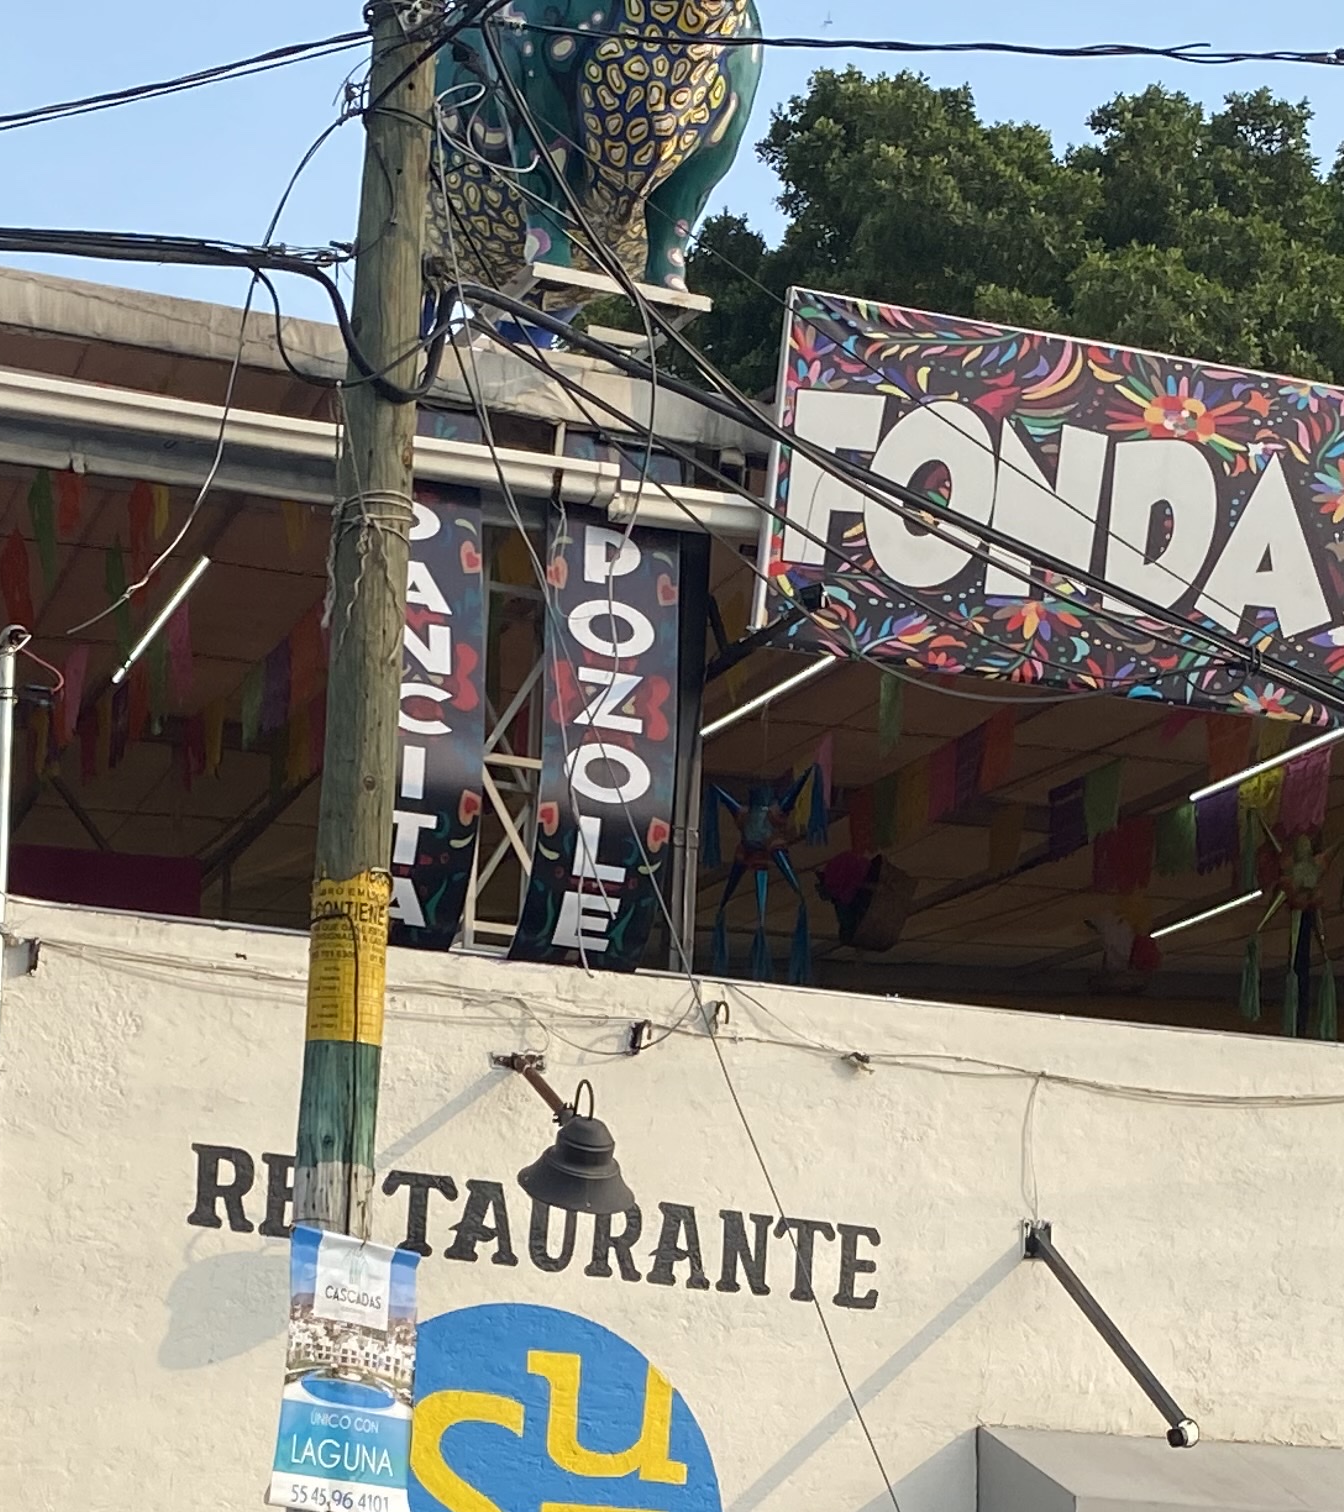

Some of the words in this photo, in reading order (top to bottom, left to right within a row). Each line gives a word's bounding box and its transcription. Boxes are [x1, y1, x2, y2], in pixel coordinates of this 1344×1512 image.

[781, 388, 1333, 644] FONDA
[551, 524, 655, 953] POZOLE
[187, 1143, 881, 1310] RETAURANTE
[325, 1285, 382, 1310] CASCADAS
[354, 1417, 380, 1435] CON
[291, 1433, 394, 1477] LAGUNA
[291, 1484, 309, 1504] 55
[331, 1489, 354, 1510] 96
